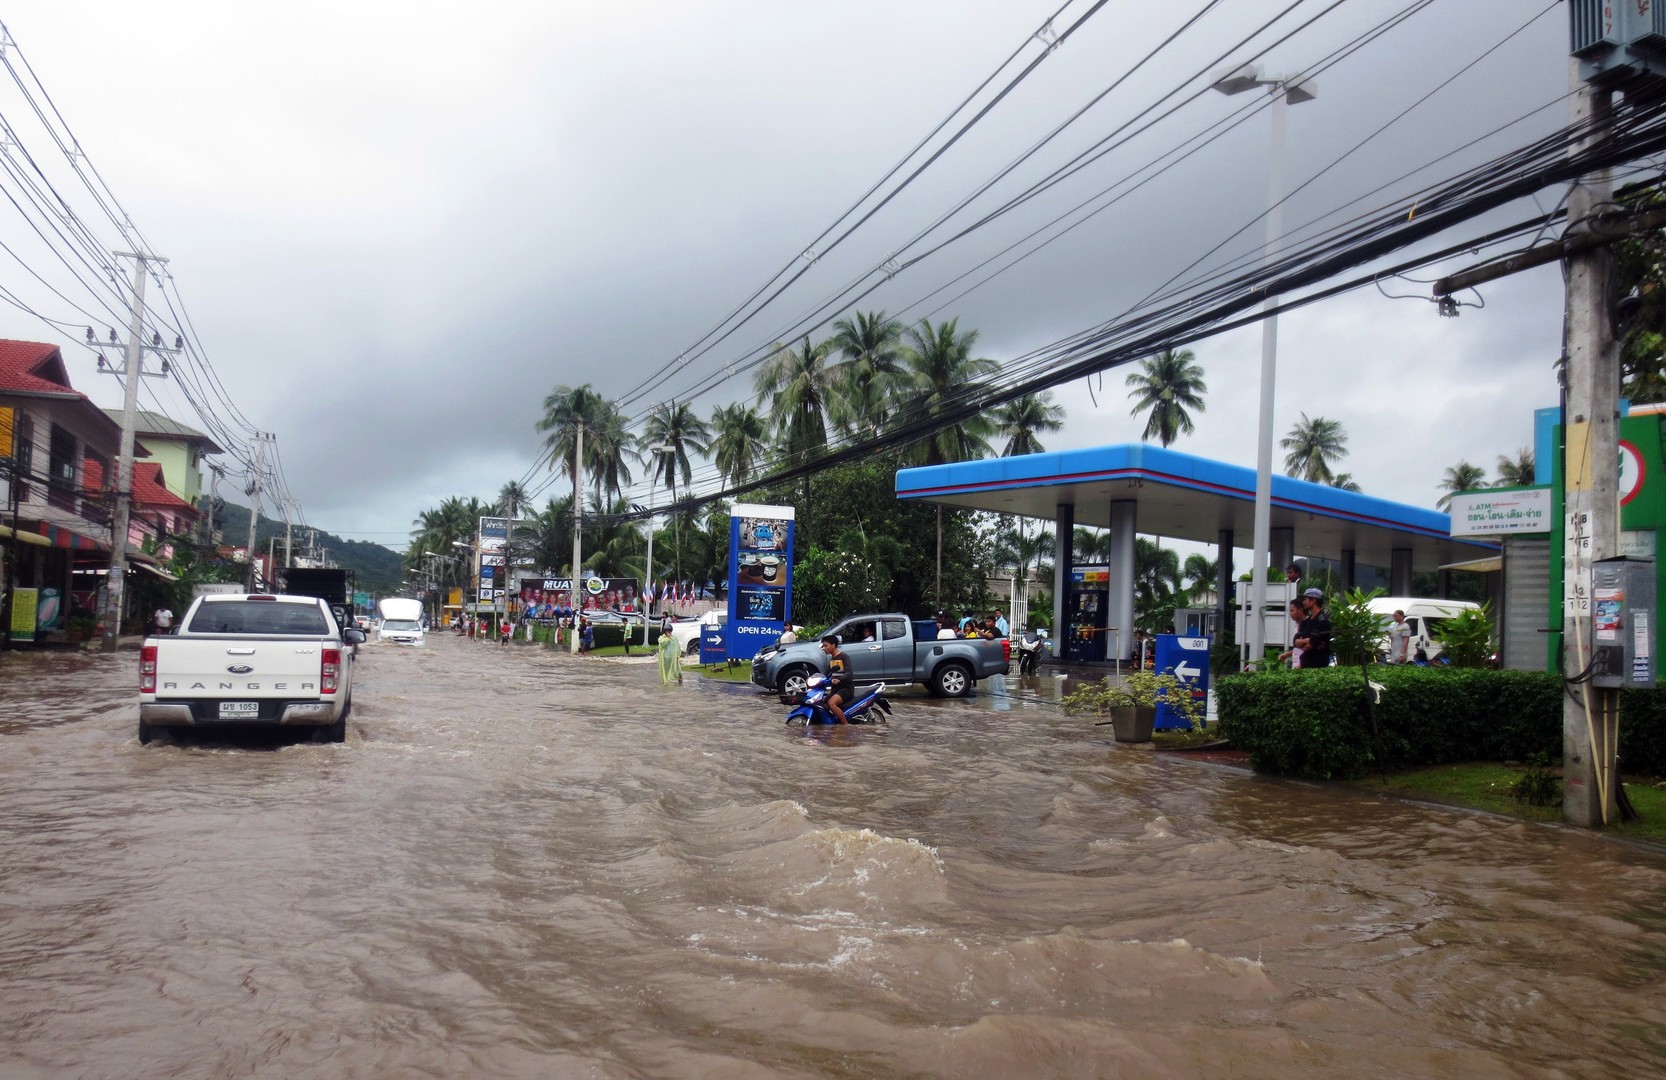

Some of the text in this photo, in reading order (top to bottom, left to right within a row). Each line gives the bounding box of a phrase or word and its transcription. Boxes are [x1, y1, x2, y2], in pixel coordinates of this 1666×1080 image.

[738, 626, 760, 635] OPEN
[761, 626, 772, 635] 24
[163, 682, 314, 690] RANGER
[239, 703, 258, 711] 1053
